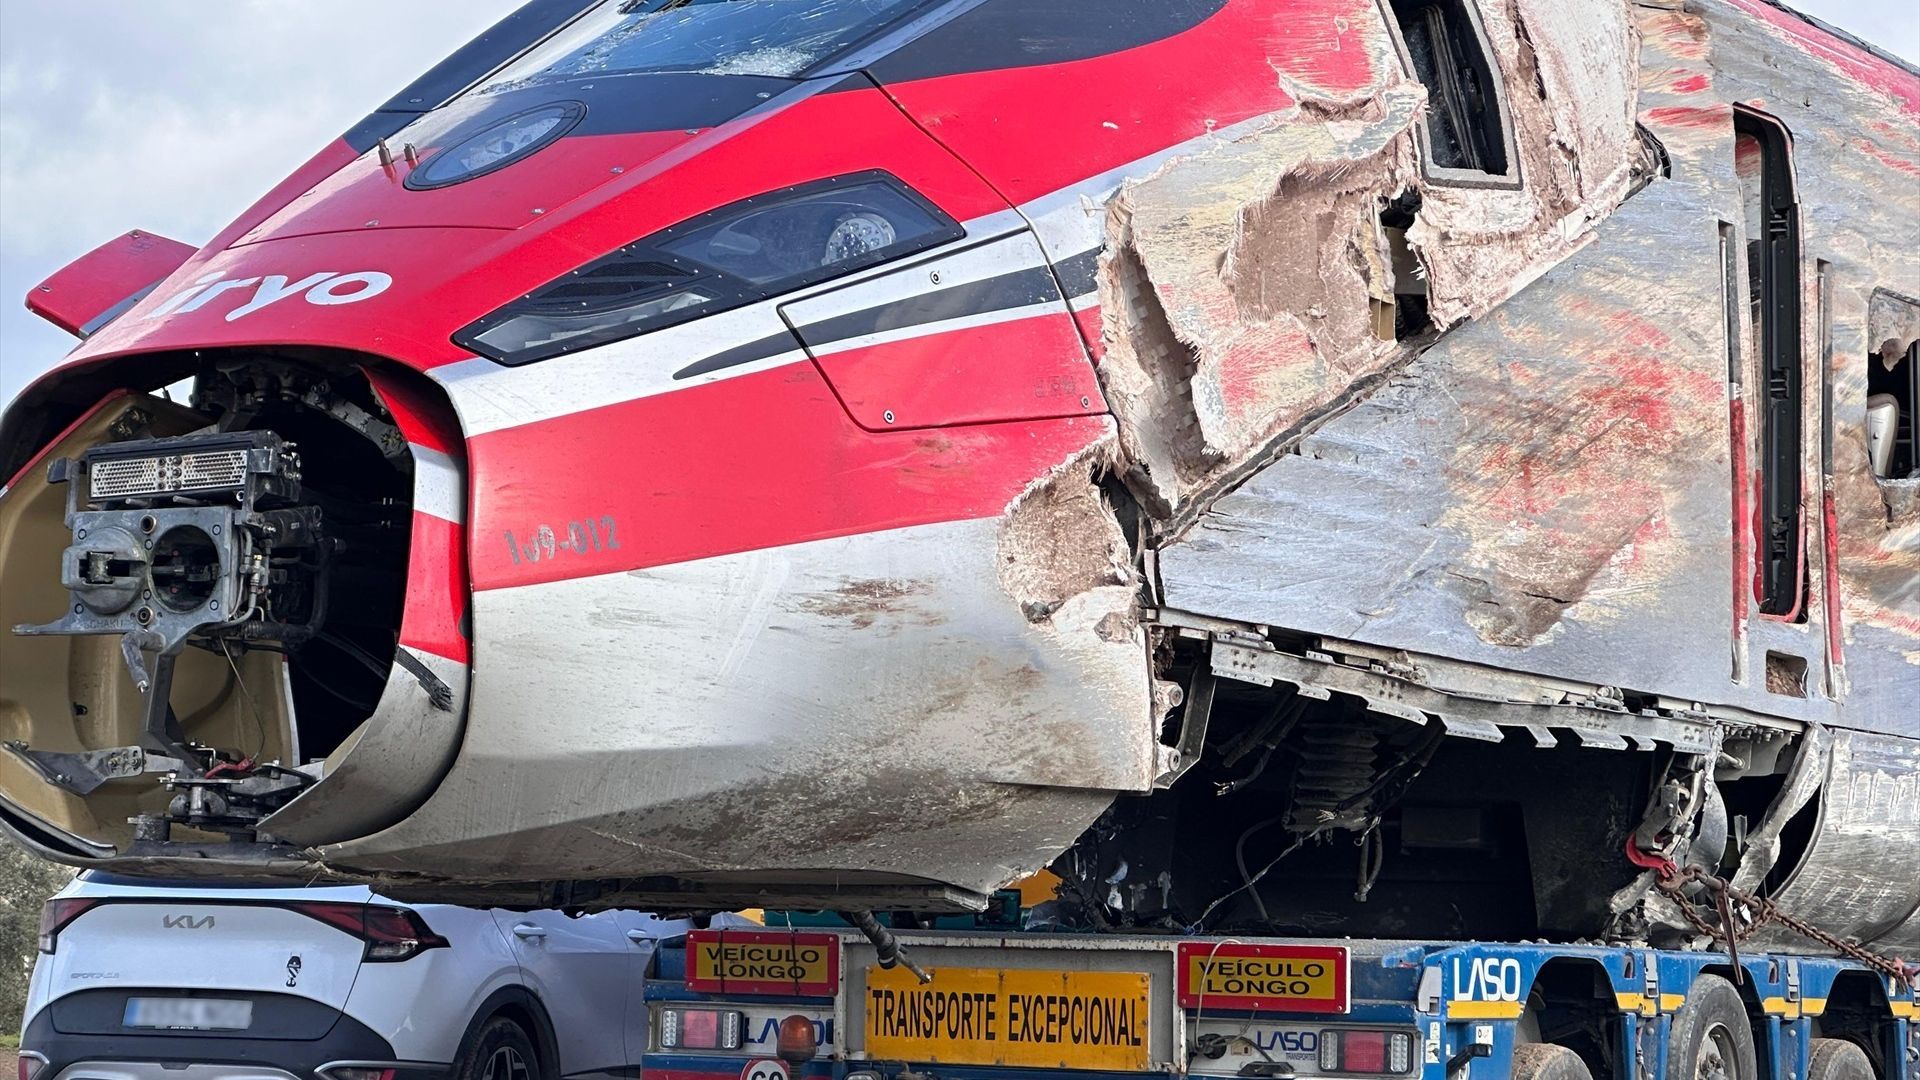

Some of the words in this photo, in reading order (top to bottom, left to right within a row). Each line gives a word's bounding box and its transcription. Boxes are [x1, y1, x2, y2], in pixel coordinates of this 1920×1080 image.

[140, 271, 393, 322] iryo
[162, 914, 216, 929] KIA
[706, 945, 820, 963] VEÍCULO
[713, 964, 806, 979] LONGO
[1199, 958, 1325, 978] VEÍCULO
[1207, 979, 1310, 995] LONGO
[1454, 957, 1521, 1001] LASO
[872, 990, 996, 1041] TRANSPORTE
[1008, 994, 1142, 1047] EXCEPCIONAL
[744, 1017, 825, 1046] LAO
[1257, 1031, 1318, 1051] LASO
